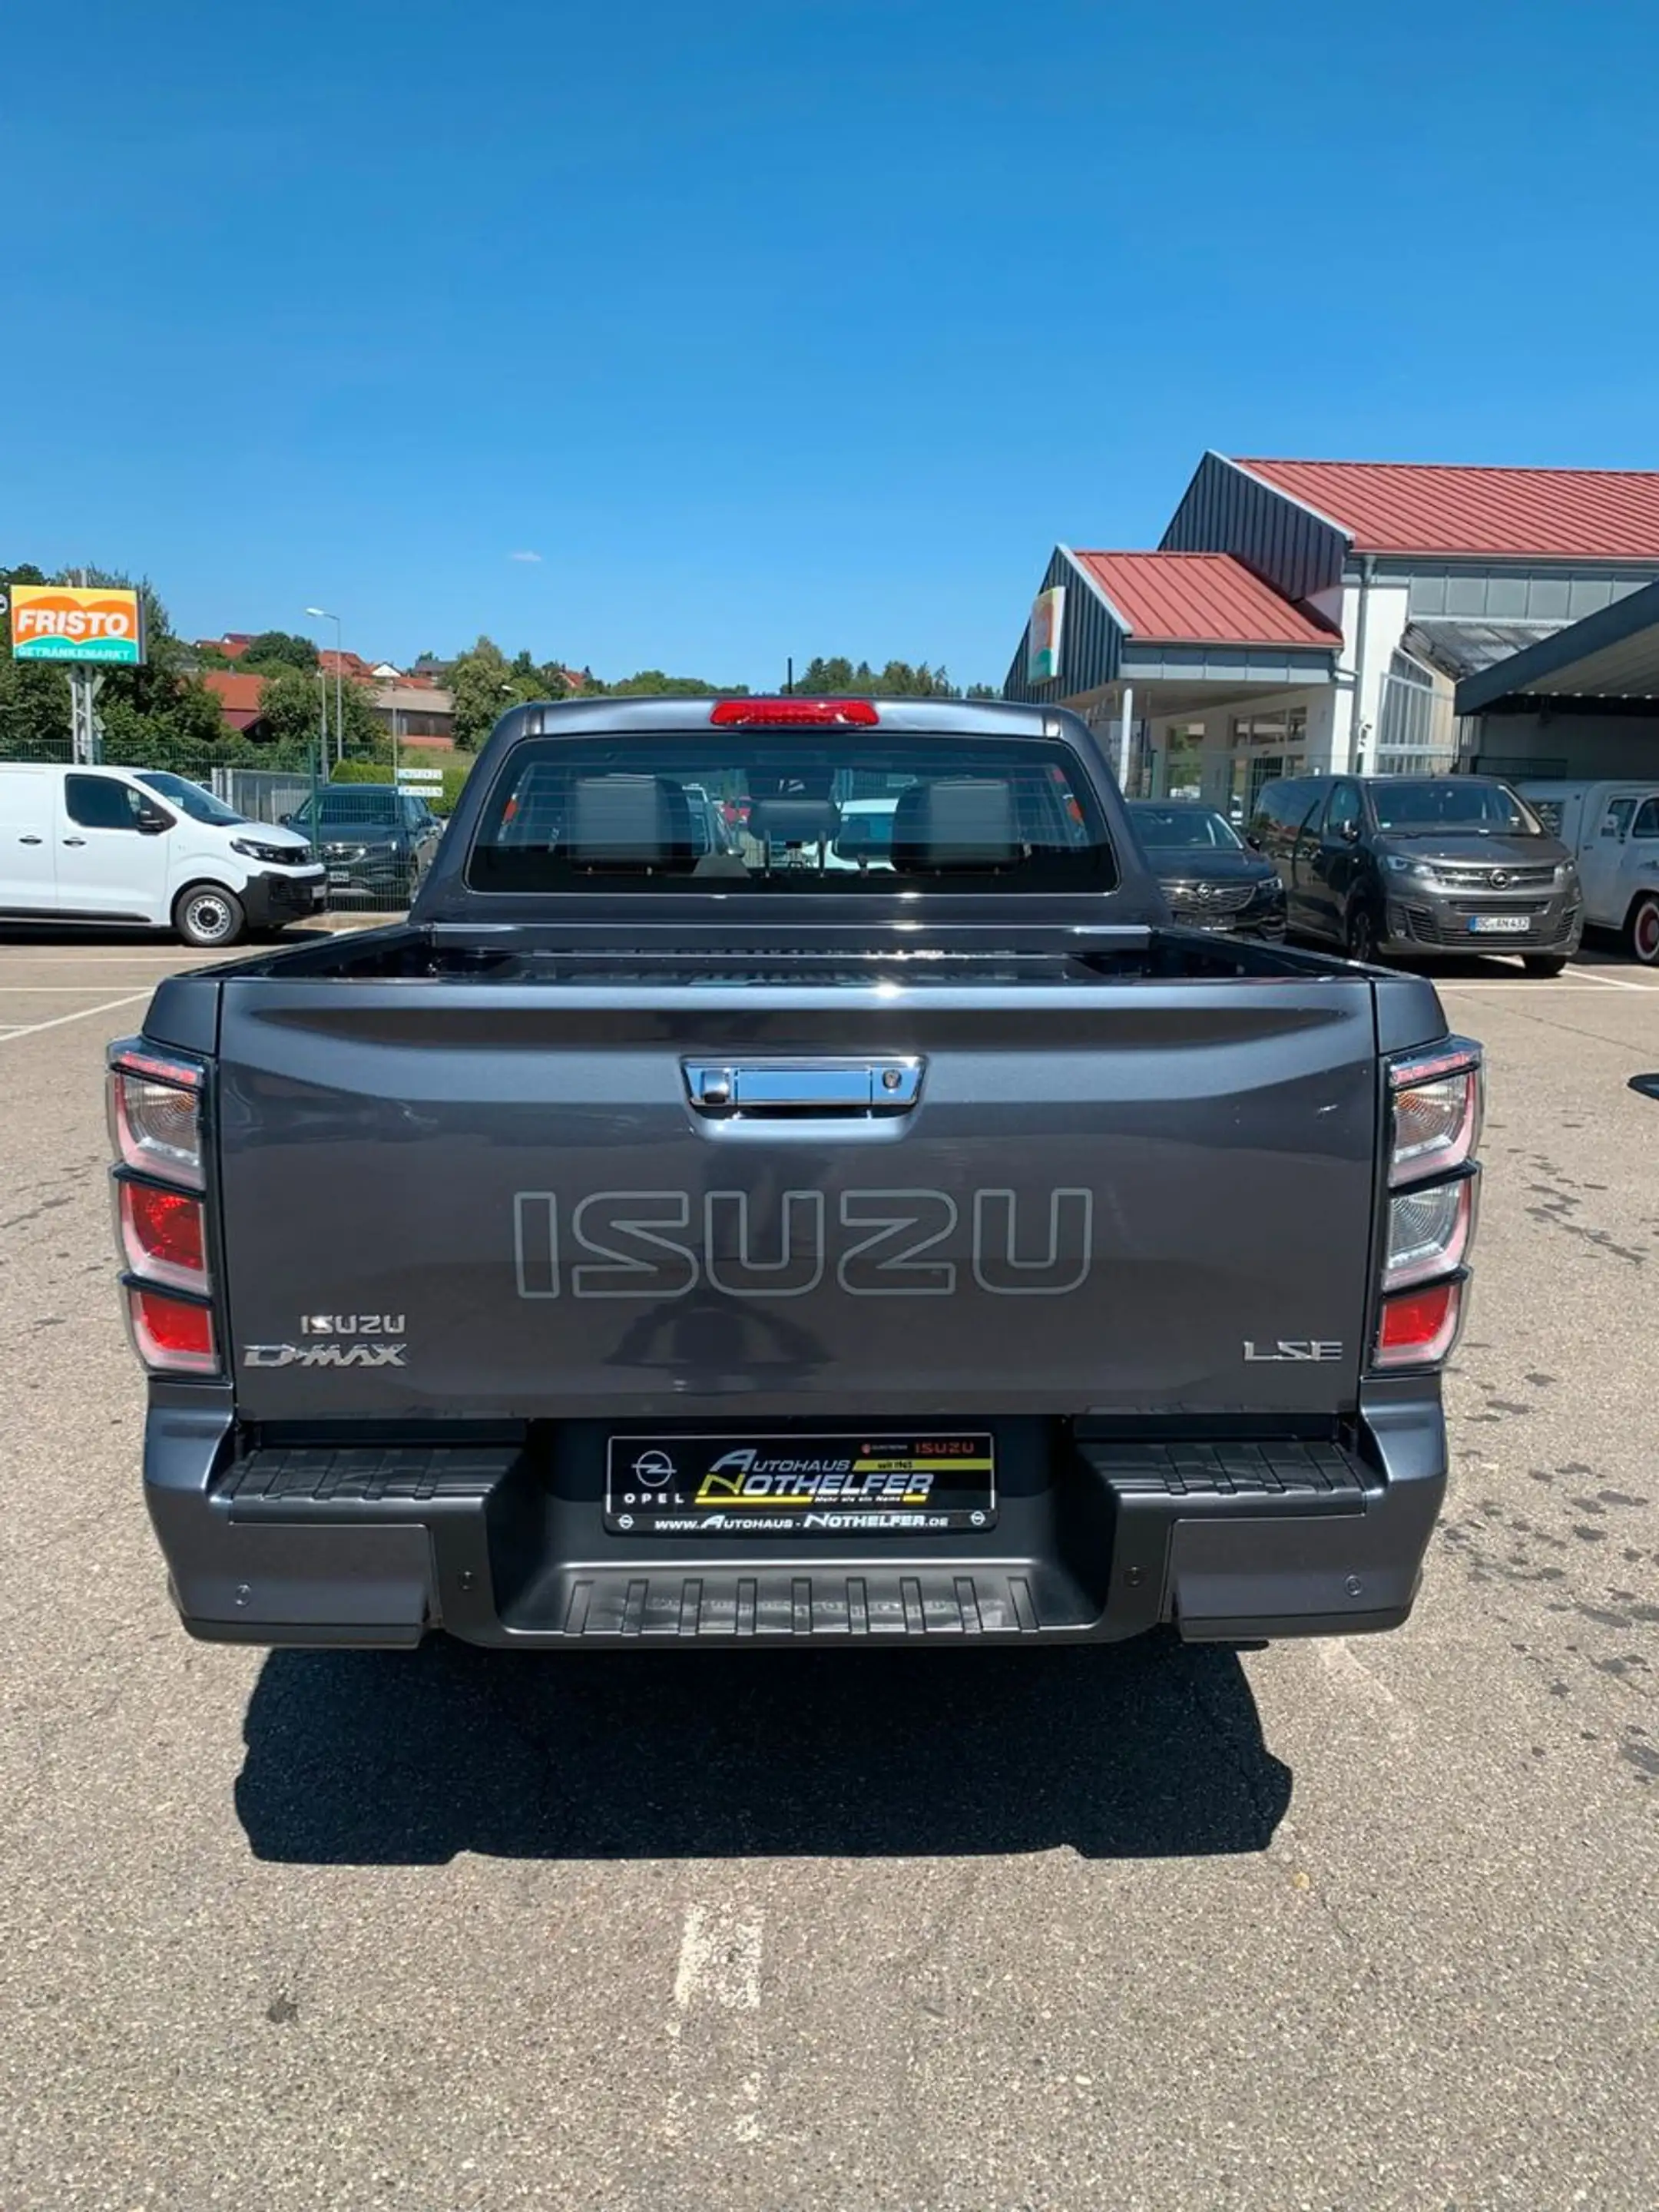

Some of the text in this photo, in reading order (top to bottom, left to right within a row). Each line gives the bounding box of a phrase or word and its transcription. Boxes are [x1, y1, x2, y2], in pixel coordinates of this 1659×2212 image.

[17, 609, 129, 637] FRISTO
[514, 1188, 1093, 1299] ISUZU
[300, 1314, 406, 1334] ISUZU
[243, 1343, 408, 1367] D-MAX
[1243, 1340, 1343, 1361] LSE
[914, 1442, 975, 1454] ISUZU
[709, 1449, 850, 1472] AUTOHAUS
[700, 1473, 934, 1495] NOTHELFER
[624, 1492, 684, 1504] OPEL
